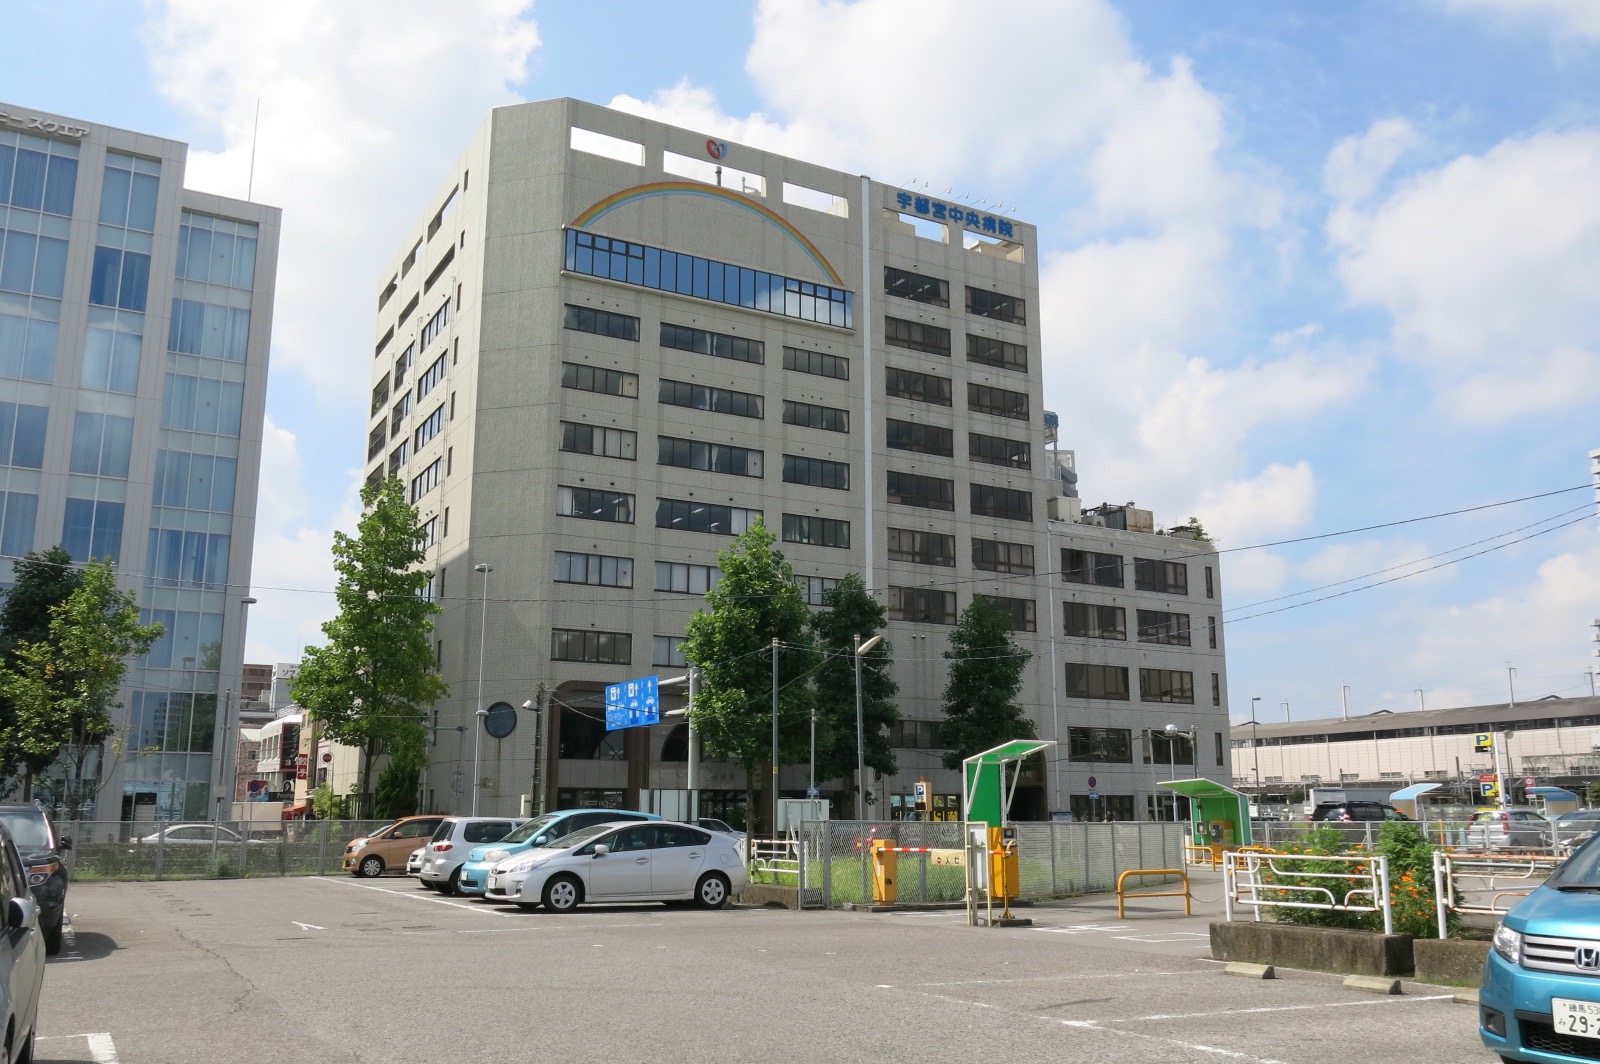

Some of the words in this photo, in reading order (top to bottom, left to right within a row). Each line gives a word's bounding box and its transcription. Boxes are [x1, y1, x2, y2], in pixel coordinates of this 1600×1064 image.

[896, 191, 1014, 238] 宇都宮中央病院
[1476, 734, 1489, 745] P
[917, 785, 924, 795] P
[1482, 783, 1494, 795] P
[1587, 1005, 1600, 1015] 53
